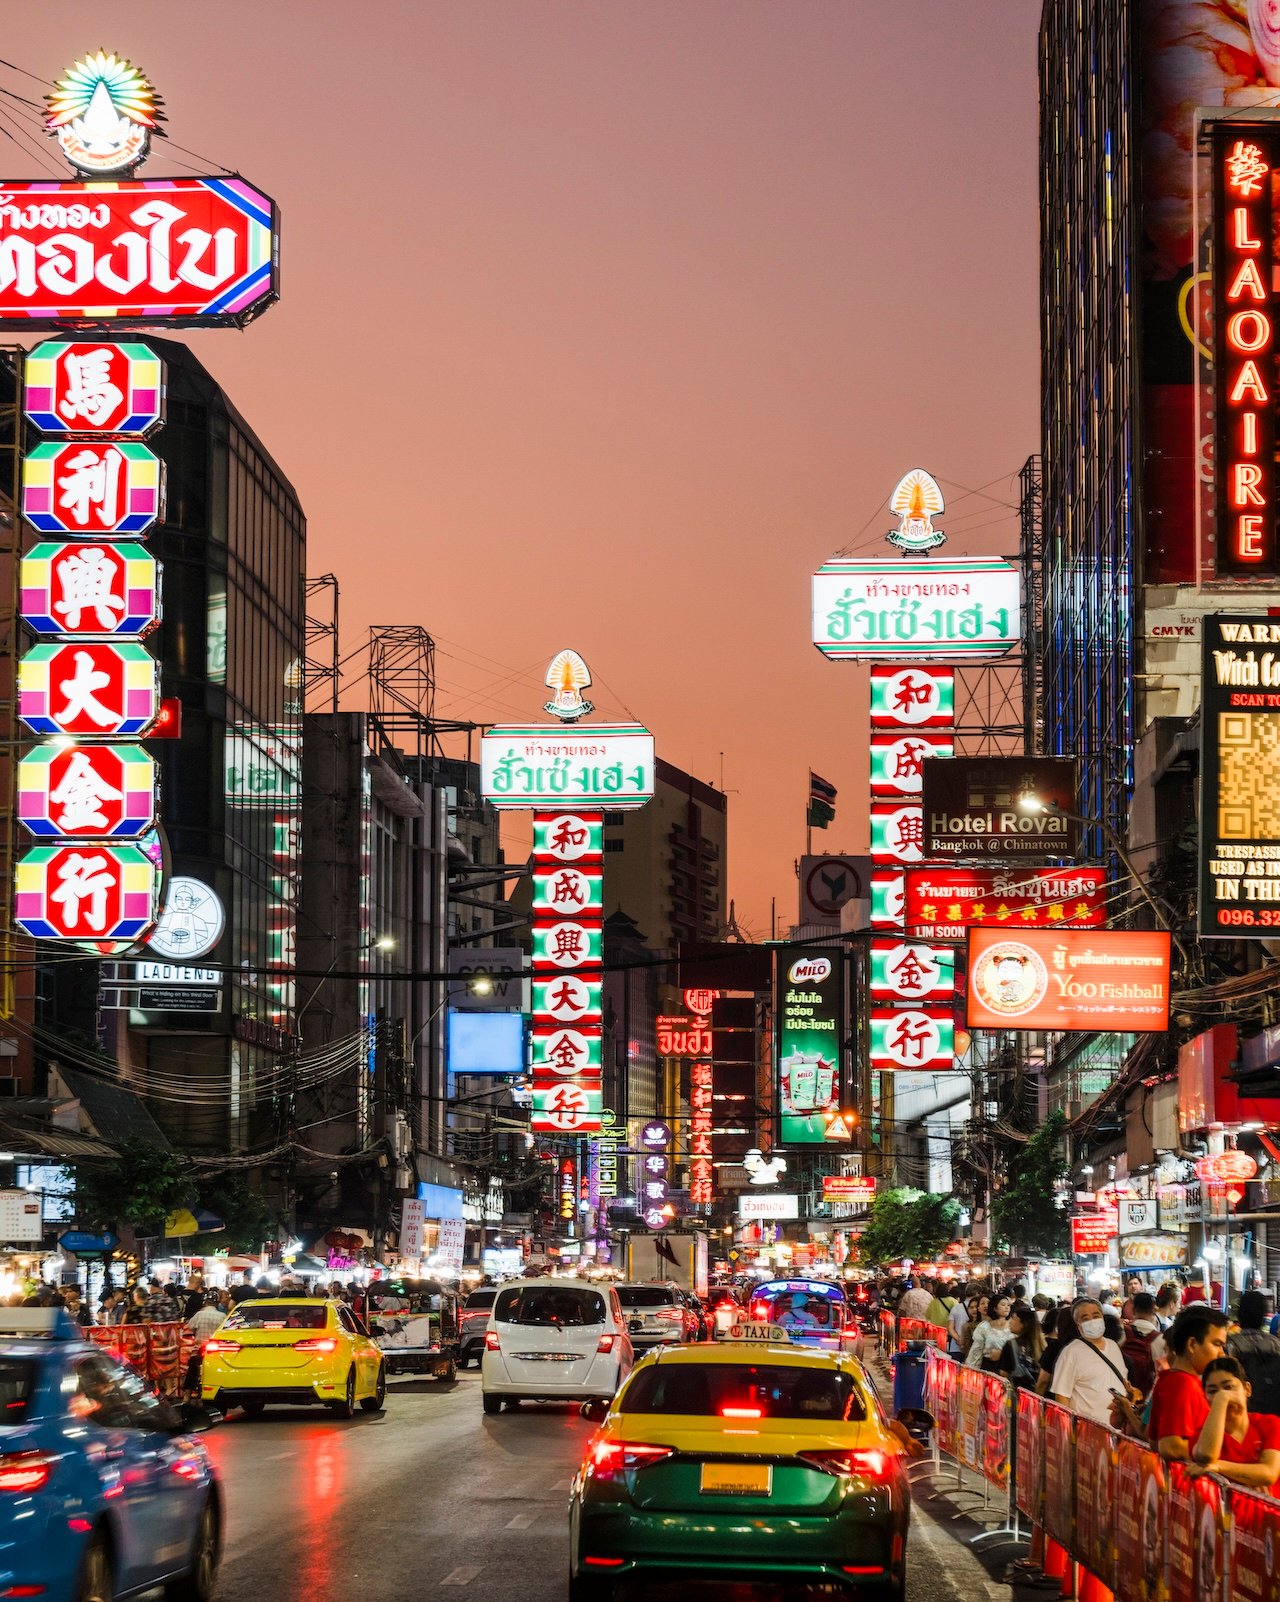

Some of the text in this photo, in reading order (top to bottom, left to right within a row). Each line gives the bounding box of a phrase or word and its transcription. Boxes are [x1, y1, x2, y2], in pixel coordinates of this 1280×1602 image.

[866, 579, 970, 597] ห้างขายทอง
[1152, 626, 1195, 636] CMYK
[1211, 650, 1259, 686] Witch
[1233, 694, 1264, 706] SCAN
[525, 741, 607, 756] ห้างขายทอง
[931, 813, 1068, 835] Hotel Royal
[932, 838, 1068, 853] Bangkok @ Chinatown
[1209, 860, 1245, 875] USED
[1246, 861, 1264, 876] AS
[916, 881, 985, 897] ร้านขายยา
[1215, 878, 1241, 900] IN
[916, 926, 965, 938] LIM SOON
[795, 965, 827, 977] MILO
[1052, 973, 1163, 999] Yoo Fishball
[784, 1004, 814, 1016] อร่อย
[743, 1325, 770, 1340] TAXI
